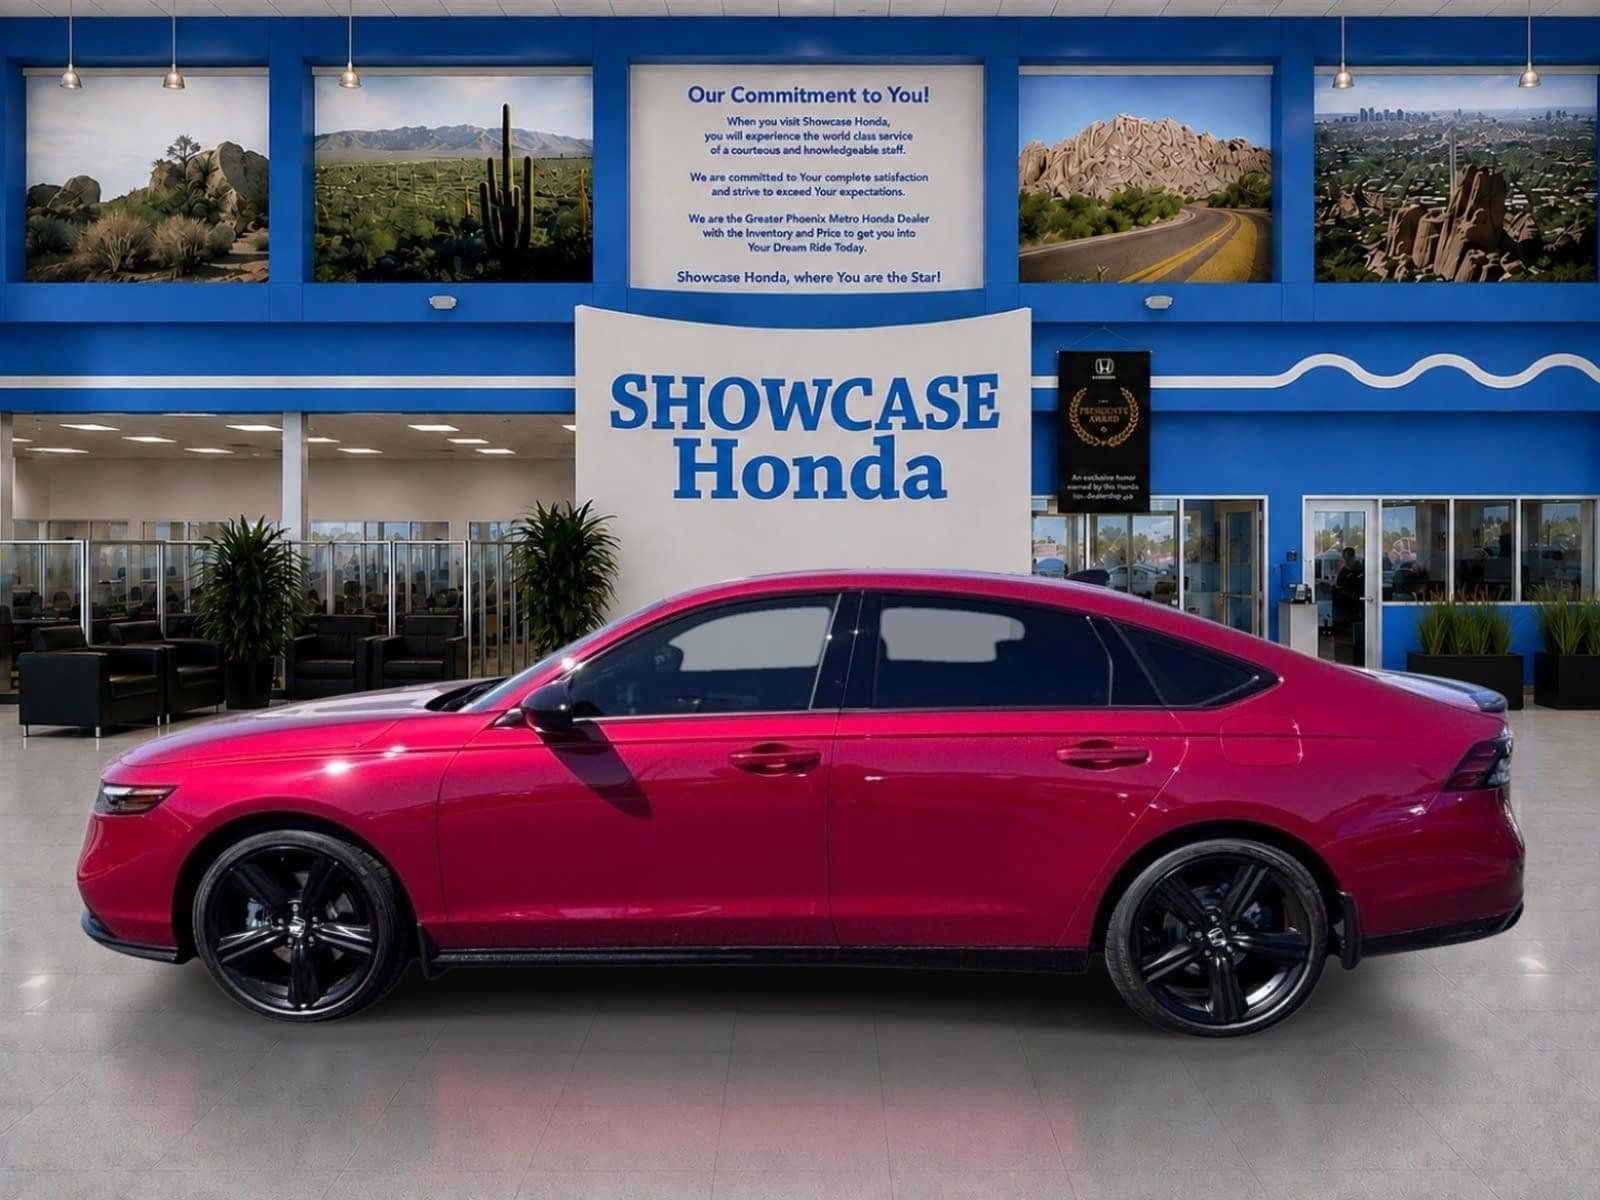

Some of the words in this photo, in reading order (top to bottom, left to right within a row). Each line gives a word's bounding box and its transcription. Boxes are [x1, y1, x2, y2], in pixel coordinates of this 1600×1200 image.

[688, 86, 726, 103] Our
[731, 86, 856, 103] Commitment
[862, 88, 882, 103] to
[887, 86, 929, 103] You!
[727, 116, 756, 126] When
[758, 119, 777, 128] you
[780, 117, 800, 126] visit
[802, 117, 852, 126] Showcase
[855, 117, 890, 128] Honda,
[705, 133, 723, 143] you
[726, 131, 743, 140] will
[745, 131, 801, 143] experience
[803, 131, 819, 141] the
[822, 131, 850, 141] world
[853, 131, 876, 141] class
[879, 131, 913, 141] service
[710, 144, 721, 155] of
[722, 147, 729, 155] a
[731, 146, 781, 155] courteous
[783, 145, 801, 155] and
[881, 144, 906, 155] staff.
[690, 172, 707, 182] We
[728, 172, 783, 182] committed
[786, 174, 797, 182] to
[800, 172, 822, 182] Your
[825, 172, 871, 184] complete
[874, 172, 928, 182] satisfaction
[712, 186, 731, 196] and
[732, 186, 760, 196] strive
[763, 188, 774, 196] to
[776, 186, 812, 196] exceed
[814, 186, 837, 196] Your
[839, 186, 905, 199] expectations.
[688, 213, 706, 224] We
[726, 213, 743, 223] the
[745, 214, 784, 224] Greater
[786, 214, 826, 223] Phoenix
[829, 214, 859, 224] Metro
[862, 214, 895, 223] Honda
[897, 213, 930, 223] Dealer
[702, 228, 724, 238] with
[727, 228, 744, 238] the
[746, 228, 793, 240] Inventory
[795, 228, 814, 238] and
[817, 228, 841, 238] Price
[844, 230, 854, 238] to
[857, 229, 874, 240] get
[876, 230, 894, 240] you
[897, 228, 916, 238] into
[748, 242, 771, 252] Your
[773, 243, 807, 253] Dream
[809, 242, 832, 252] Ride
[834, 242, 867, 255] Today.
[677, 271, 740, 283] Showcase
[745, 271, 790, 285] Honda,
[794, 271, 834, 283] where
[837, 272, 860, 283] You
[864, 274, 884, 283] are
[887, 271, 908, 283] the
[911, 271, 940, 283] Star!
[610, 373, 1000, 431] SHOWCASE
[673, 434, 948, 500] Honda
[1093, 483, 1102, 492] by
